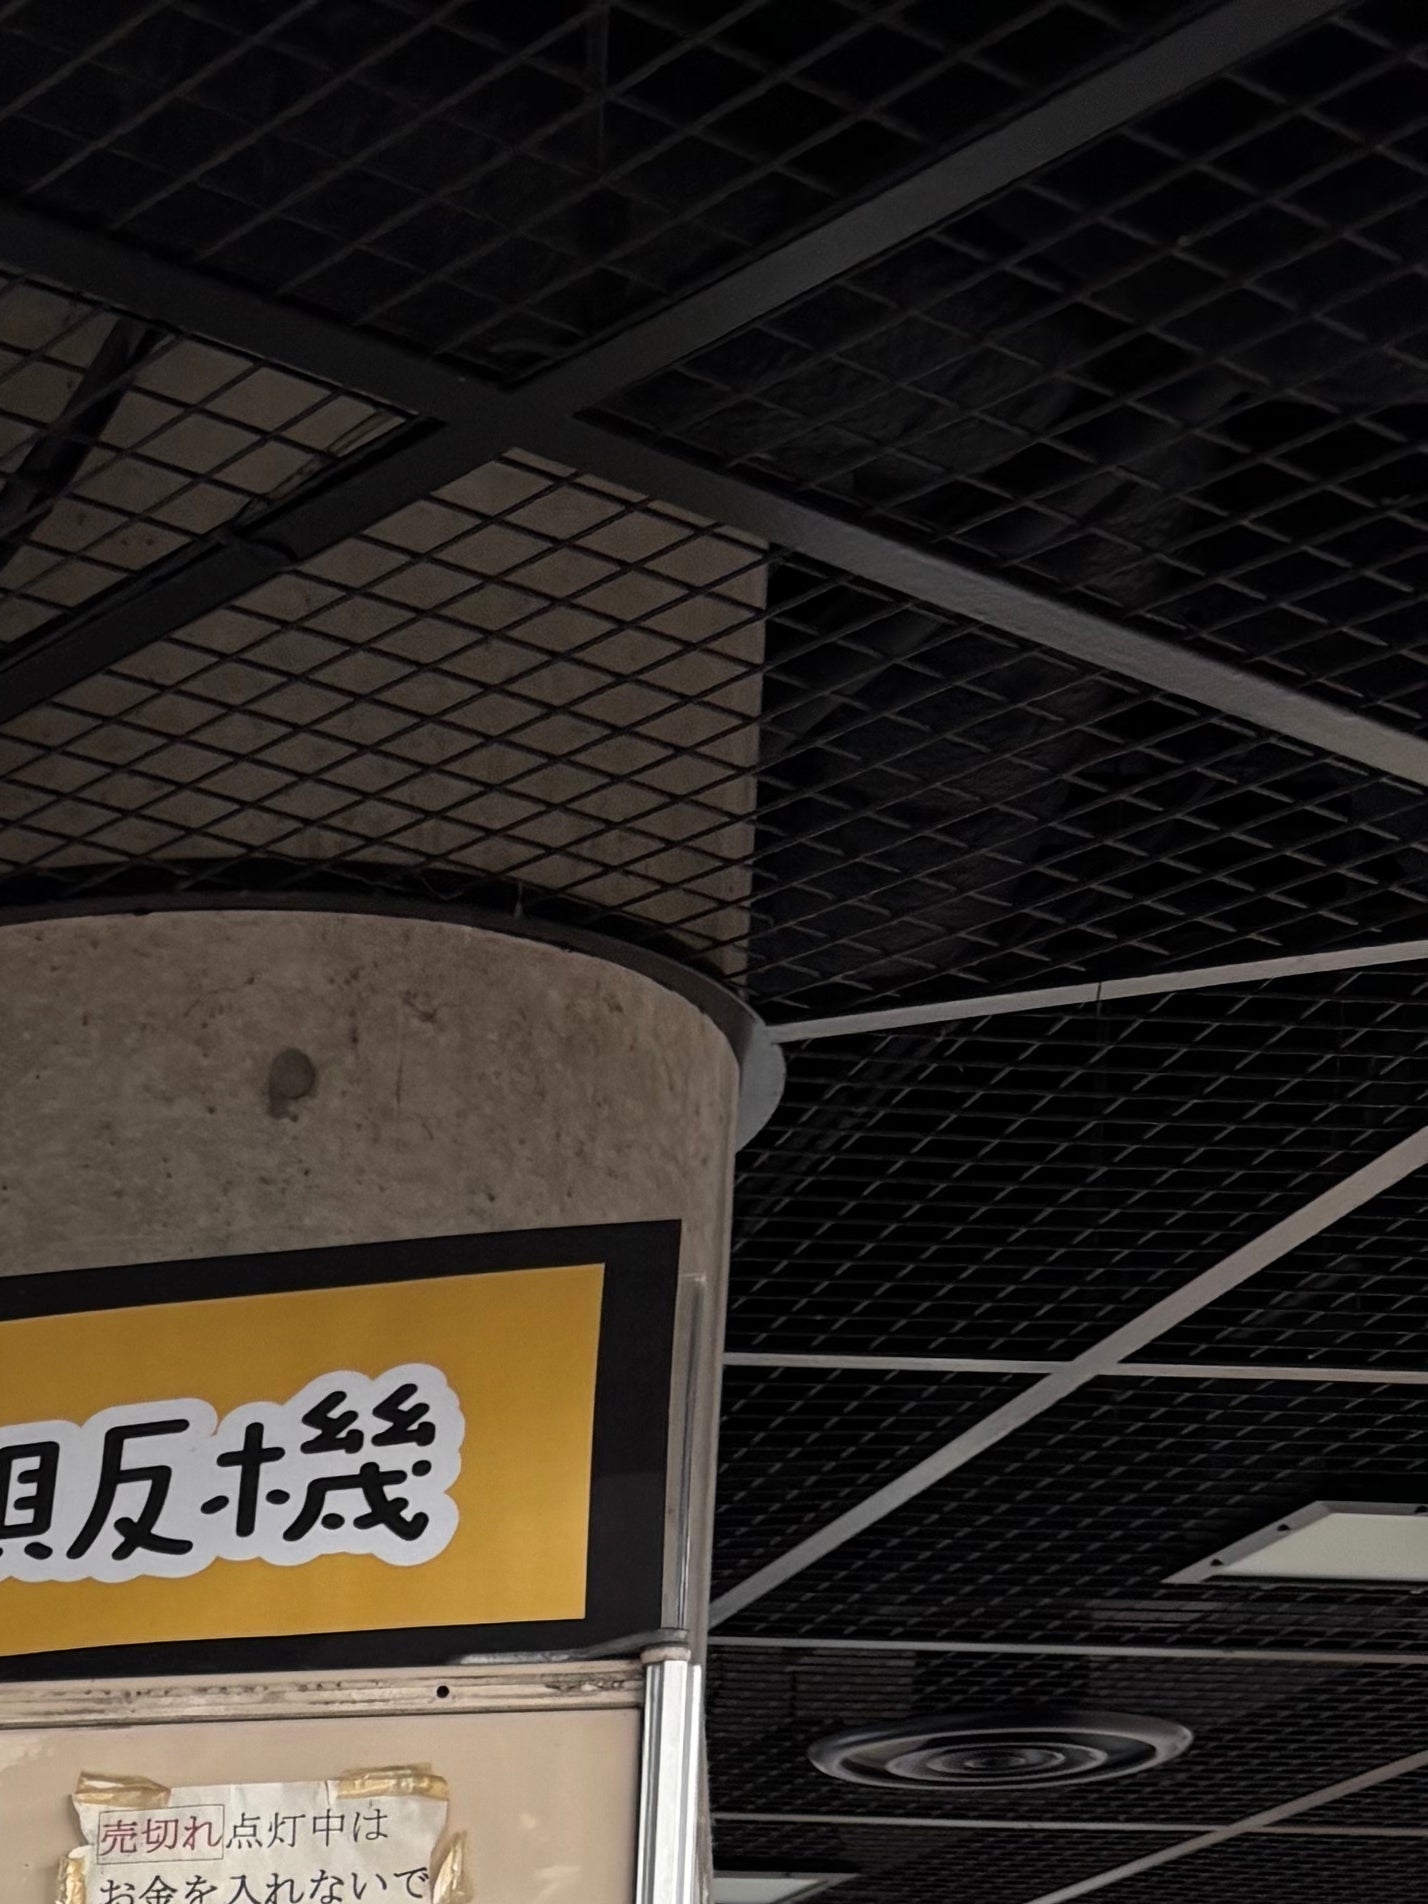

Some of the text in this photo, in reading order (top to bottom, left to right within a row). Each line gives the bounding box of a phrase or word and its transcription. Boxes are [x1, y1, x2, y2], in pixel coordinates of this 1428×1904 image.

[100, 1812, 388, 1856] 売切れ点灯中は
